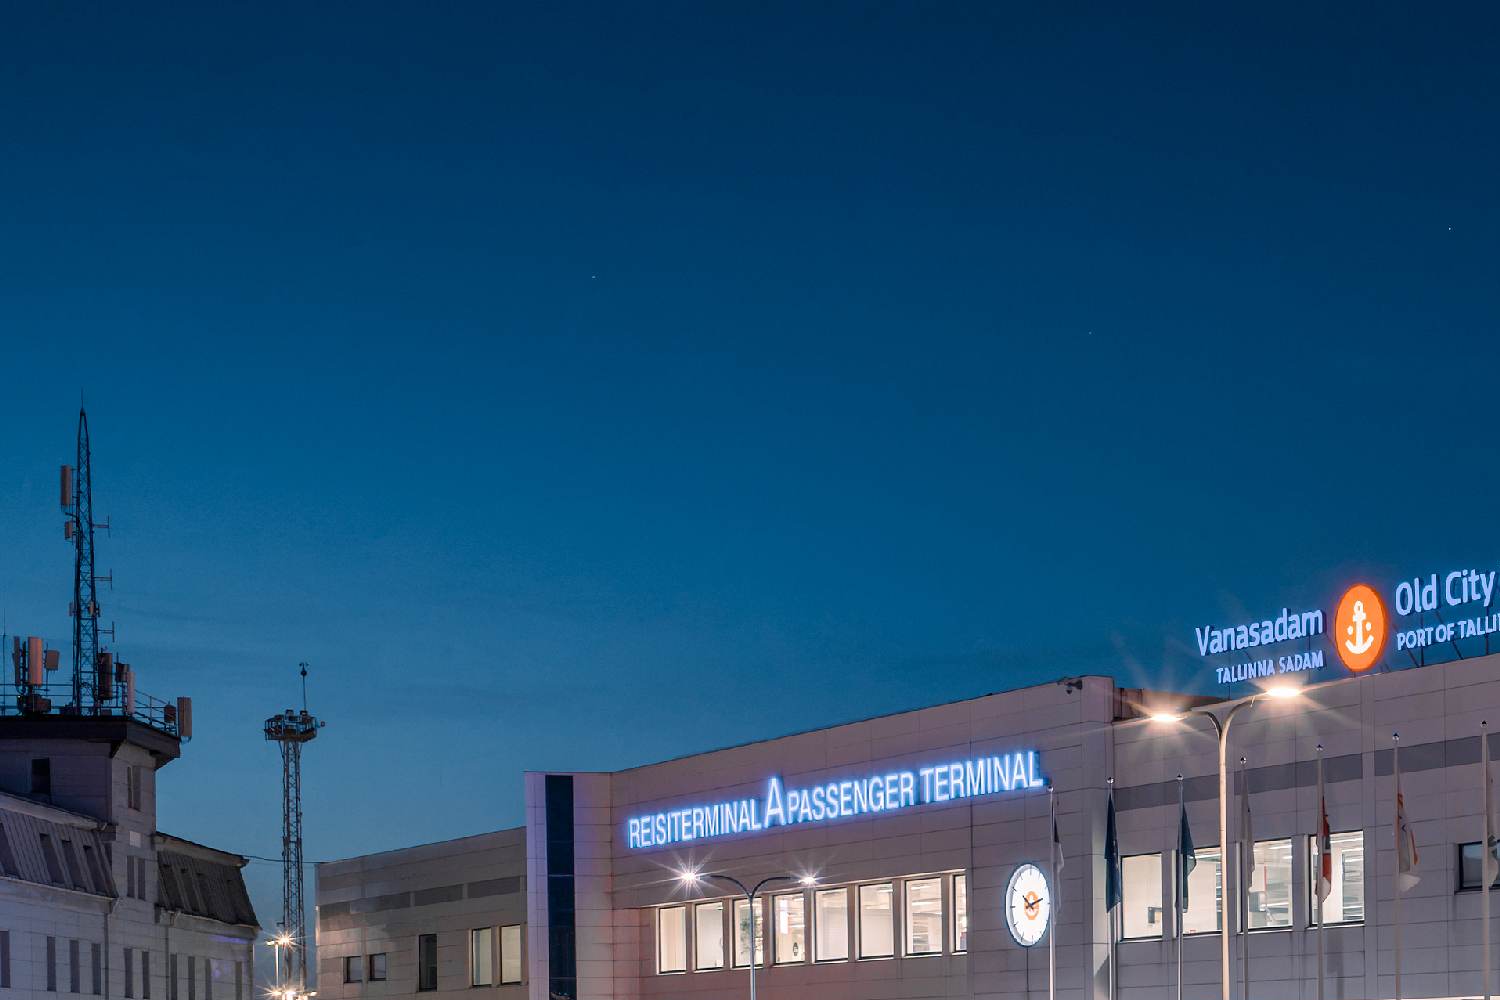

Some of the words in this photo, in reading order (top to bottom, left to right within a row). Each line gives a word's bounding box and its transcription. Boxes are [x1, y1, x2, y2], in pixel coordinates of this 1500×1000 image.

[1395, 574, 1438, 616] Old
[1445, 568, 1496, 607] City
[1195, 607, 1324, 656] Vanasadam
[1396, 627, 1434, 651] PORT
[1435, 623, 1456, 642] OF
[1215, 659, 1276, 684] TALLINNA
[1278, 650, 1324, 673] SADAM
[628, 799, 762, 849] REISITERMINAL
[764, 776, 787, 829] A
[787, 771, 914, 825] PASSENGER
[918, 750, 1044, 802] TERMINAL
